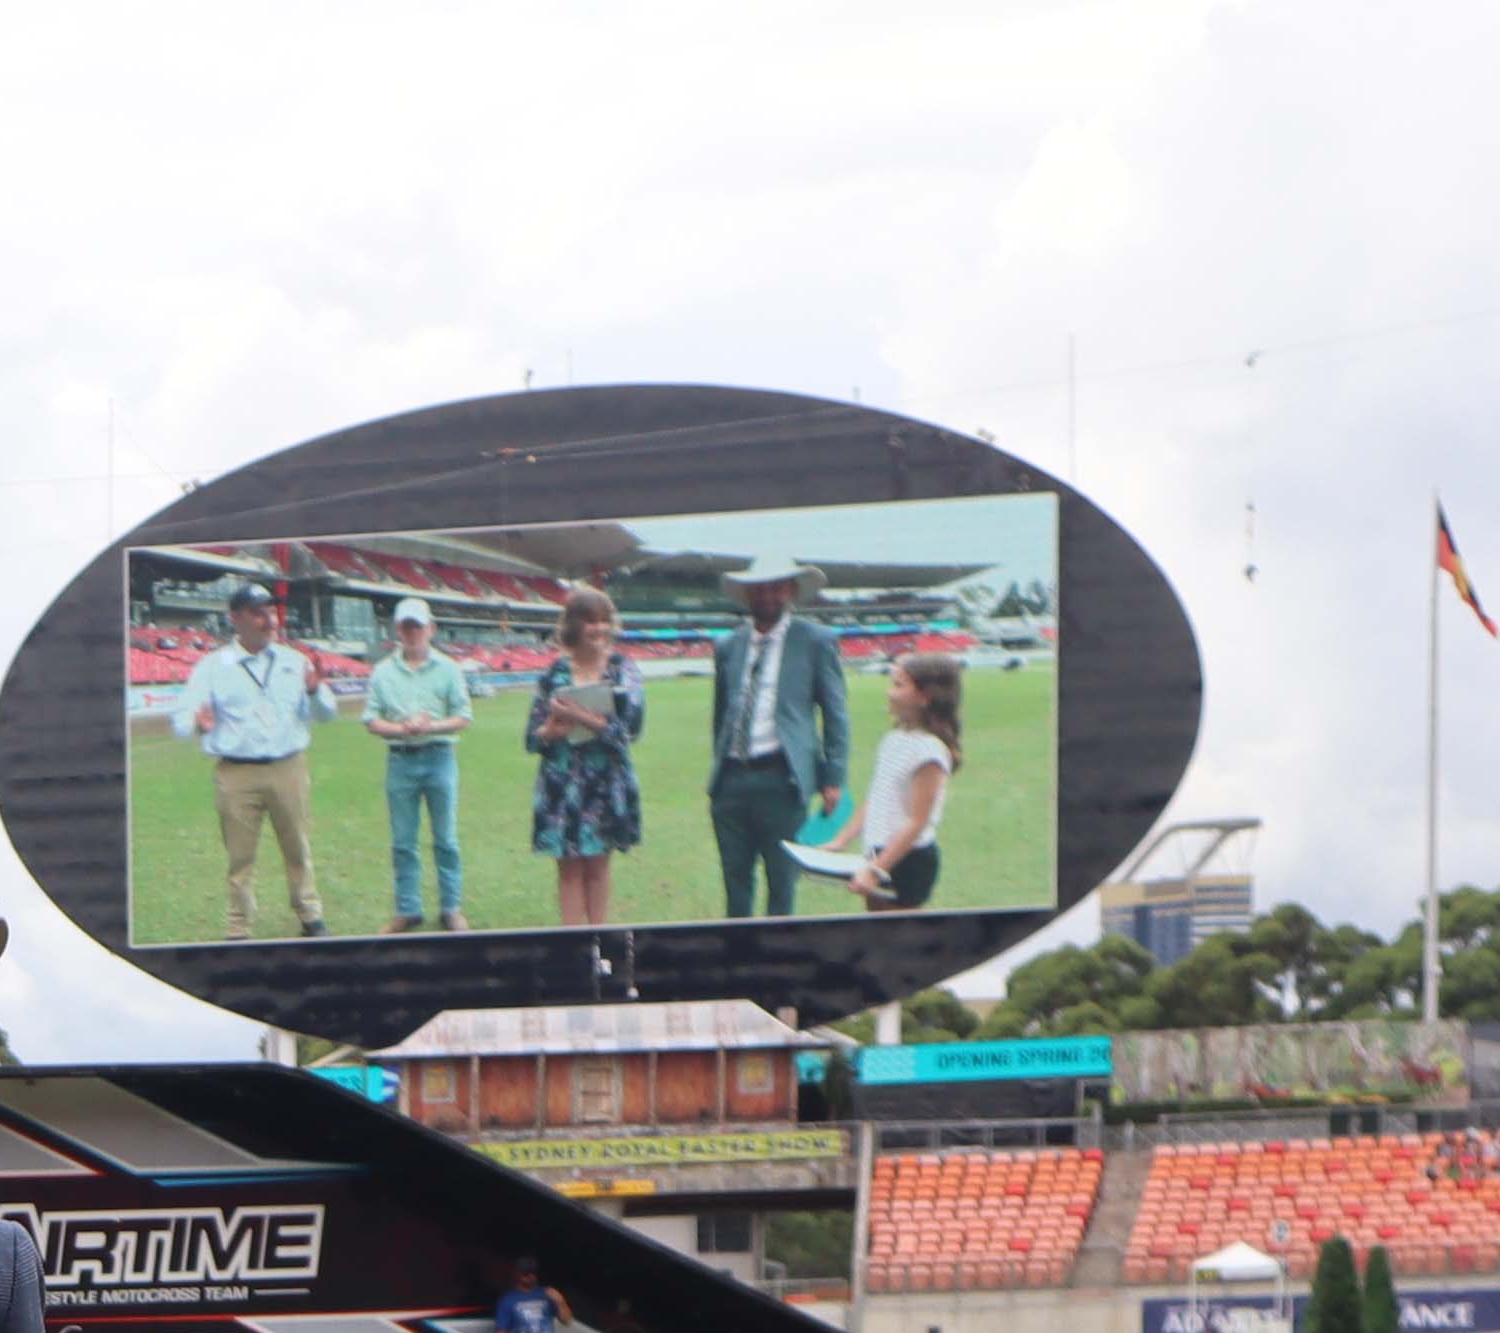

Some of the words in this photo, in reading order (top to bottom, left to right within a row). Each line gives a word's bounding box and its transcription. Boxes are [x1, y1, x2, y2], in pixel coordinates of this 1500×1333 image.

[509, 1147, 592, 1161] SYDNEY
[603, 1145, 670, 1158] ROYAL
[681, 1140, 756, 1154] EASTER
[767, 1137, 833, 1151] SHOW
[101, 1287, 200, 1304] MOTOCROSS
[204, 1285, 249, 1300] TEAM
